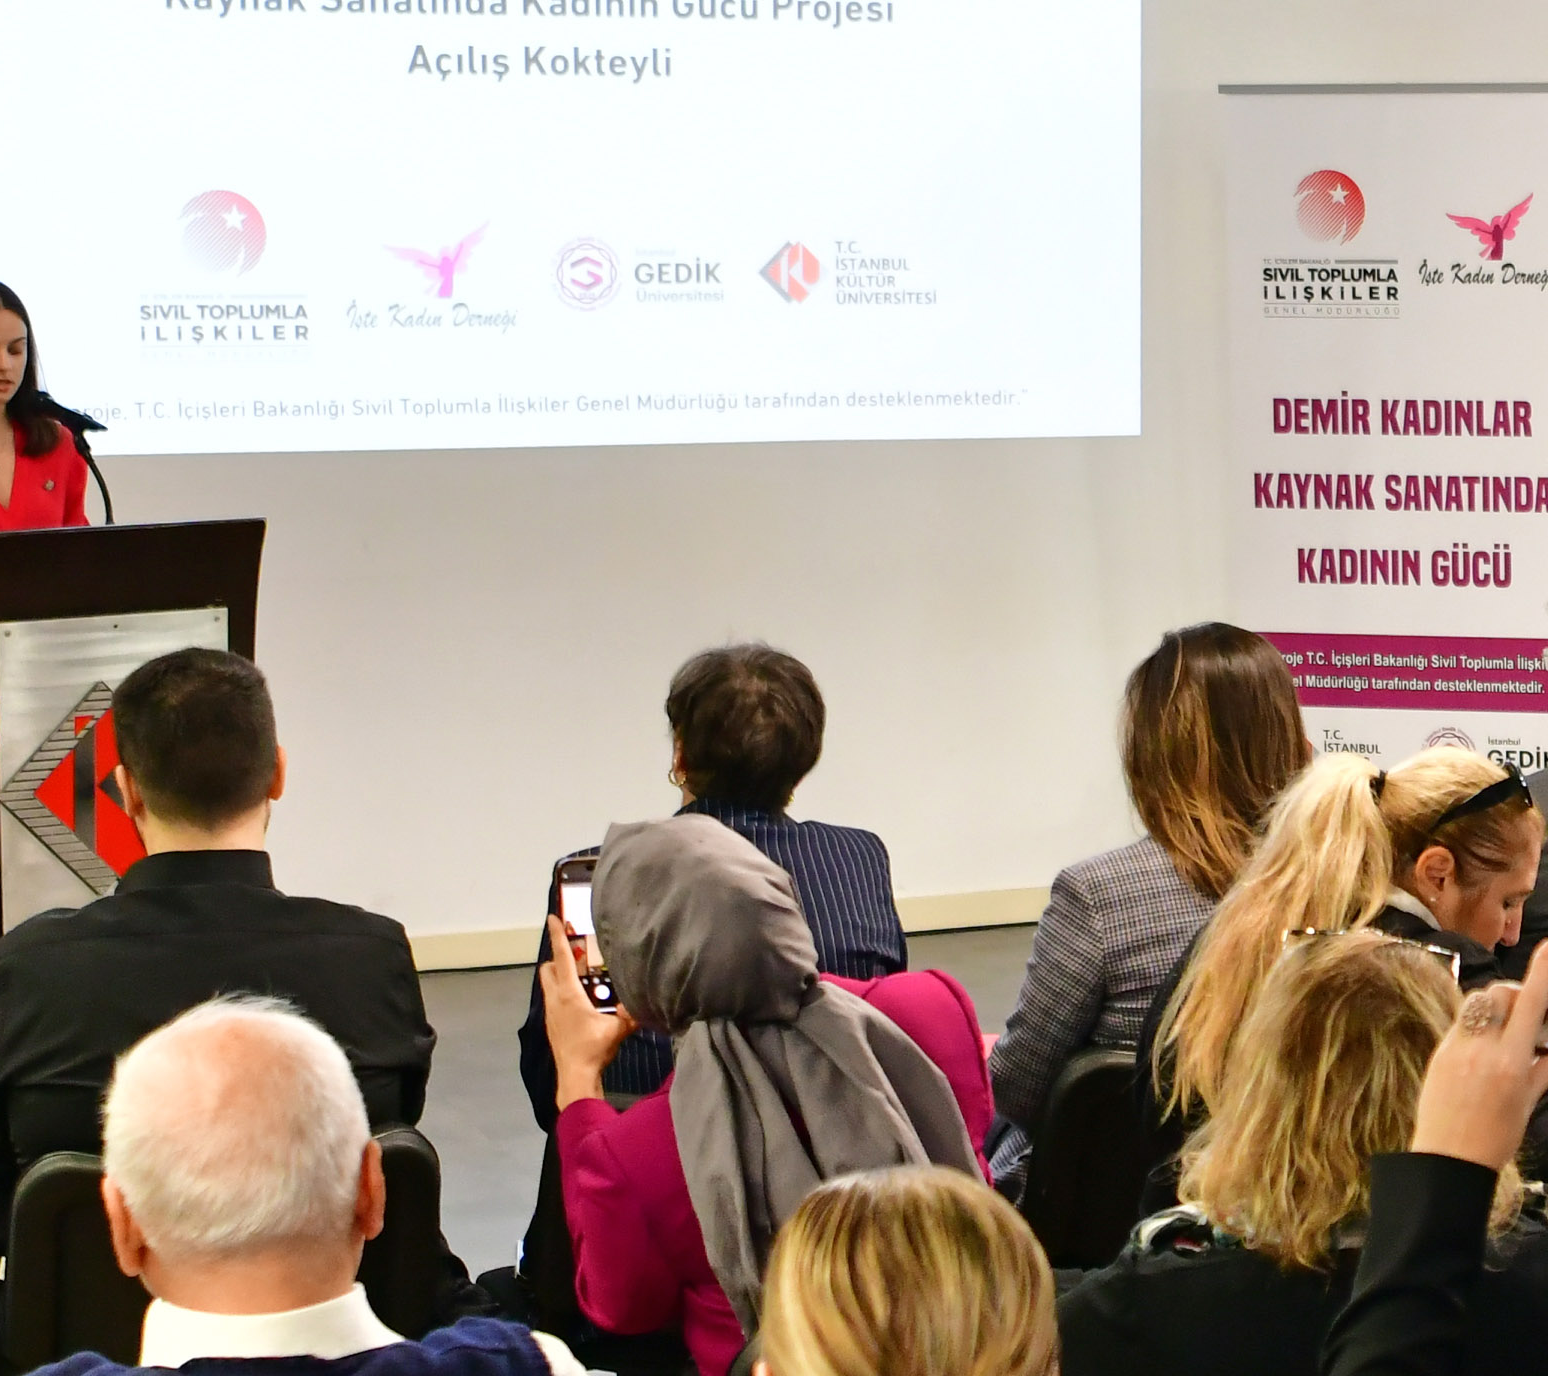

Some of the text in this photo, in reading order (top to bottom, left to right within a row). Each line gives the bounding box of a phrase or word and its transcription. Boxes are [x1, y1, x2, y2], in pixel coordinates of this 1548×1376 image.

[407, 43, 673, 86] Açılış Kokteyli
[836, 241, 861, 254] T.C.
[634, 257, 722, 284] GEDİK
[836, 256, 910, 271] İSTANBUL
[836, 274, 895, 288] KÜLTÜR
[1308, 268, 1398, 282] TOPLUMLA
[1451, 263, 1494, 285] Kadın
[636, 287, 724, 303] Üniversitesi
[836, 289, 938, 305] ÜNİVERSİTESİ
[198, 304, 308, 320] TOPLUMLA
[388, 303, 443, 329] Kadın
[451, 302, 519, 335] Derneği
[178, 399, 246, 422] İçişleri
[253, 400, 344, 421] Bakanlığı
[352, 399, 393, 416] Sivil
[400, 398, 492, 419] Toplumla
[498, 395, 570, 417] İlişkiler
[577, 395, 630, 412] Genel
[638, 393, 738, 413] Müdürlüğü
[745, 392, 840, 409] tarafından
[1273, 391, 1533, 437] DEMİR KADINLAR
[1254, 473, 1375, 510] KAYNAK
[1297, 543, 1512, 588] KADININ GÜCÜ
[1306, 652, 1328, 665] T.C.
[1332, 650, 1370, 668] İçişleri
[1374, 653, 1427, 670] Bakanlığı
[1431, 655, 1457, 669] Sivil
[1460, 656, 1514, 672] Toplumla
[1517, 655, 1546, 672] İlişki
[1306, 675, 1368, 692] Müdürlüğü
[1372, 678, 1431, 691] tarafından
[1434, 679, 1545, 694] desteklenmektedir.
[1323, 730, 1343, 740] T.C.
[1488, 736, 1521, 745] İstanbul
[1324, 740, 1381, 754] İSTANBUL
